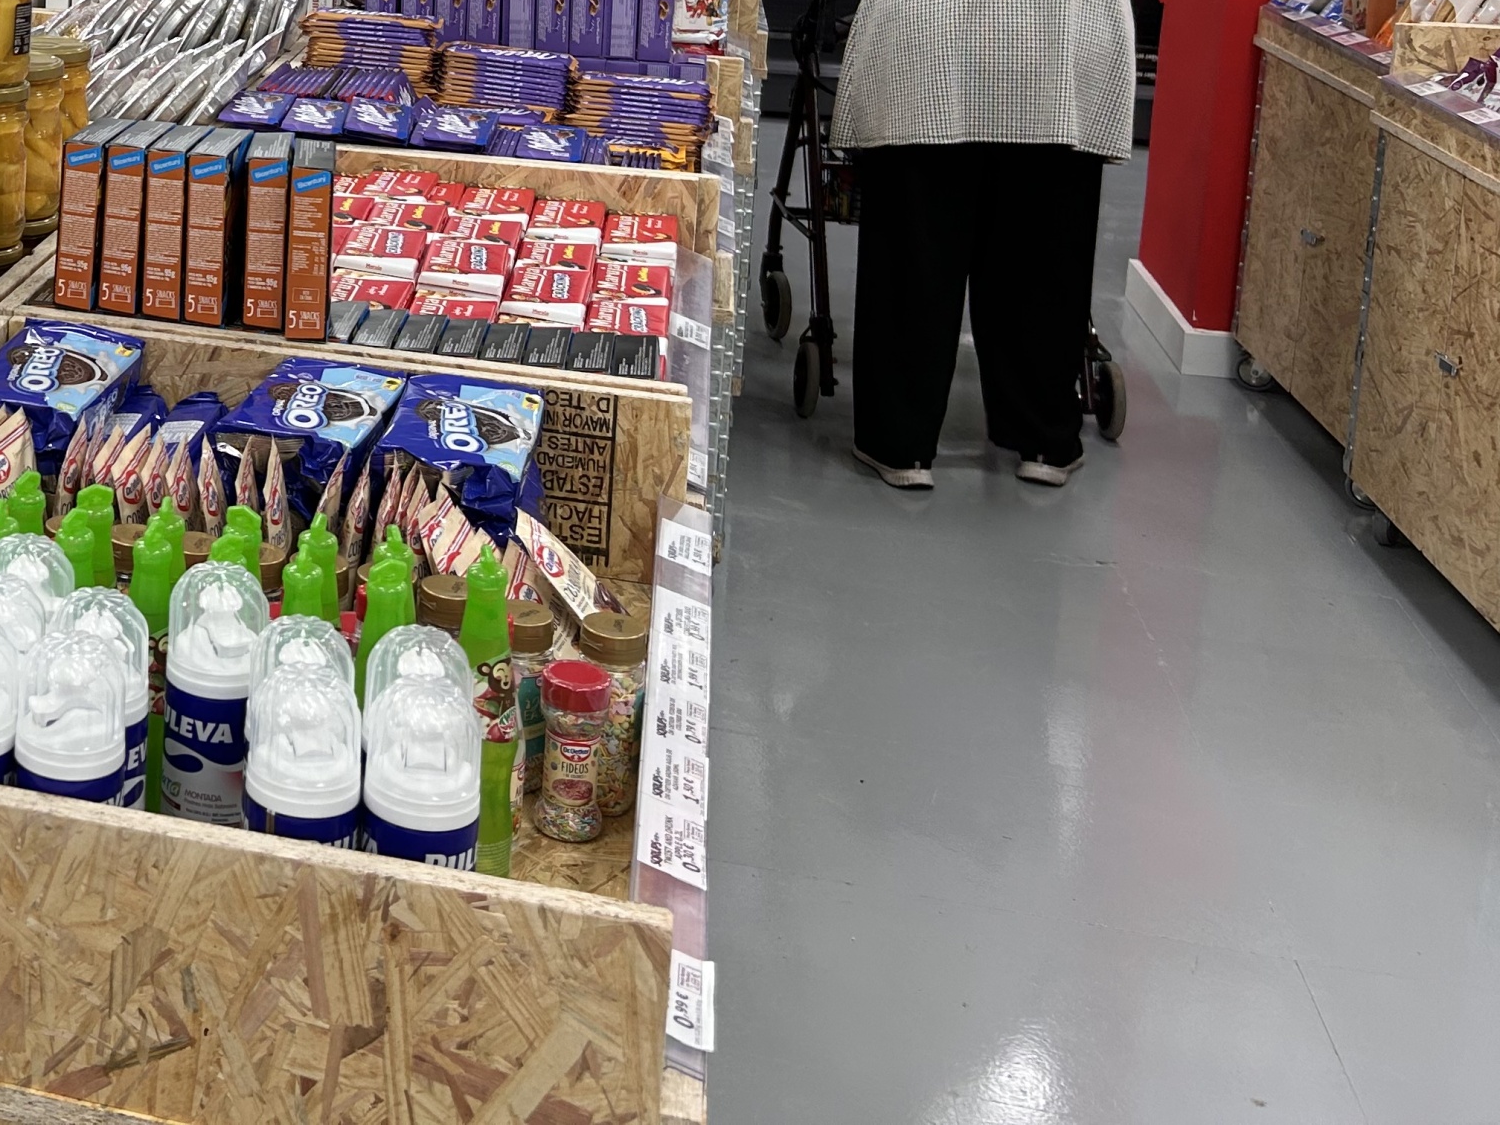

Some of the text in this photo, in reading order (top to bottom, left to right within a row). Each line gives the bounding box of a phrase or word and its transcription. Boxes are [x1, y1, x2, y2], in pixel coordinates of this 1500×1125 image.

[296, 176, 326, 191] Bicentury
[610, 216, 632, 239] Maruja
[76, 259, 88, 271] 95g
[58, 279, 87, 297] 5 SNACKS
[188, 295, 218, 313] 5 SNACKS
[289, 310, 297, 329] 5
[19, 347, 61, 392] OREO
[285, 384, 328, 430] OREO
[562, 411, 610, 433] MAYOR
[548, 436, 607, 456] ANTES
[536, 451, 606, 472] HUMEDAD
[542, 469, 603, 497] ESTAB
[166, 703, 233, 743] LEVA
[561, 762, 589, 774] FIDEOS
[185, 789, 222, 802] MONTADA
